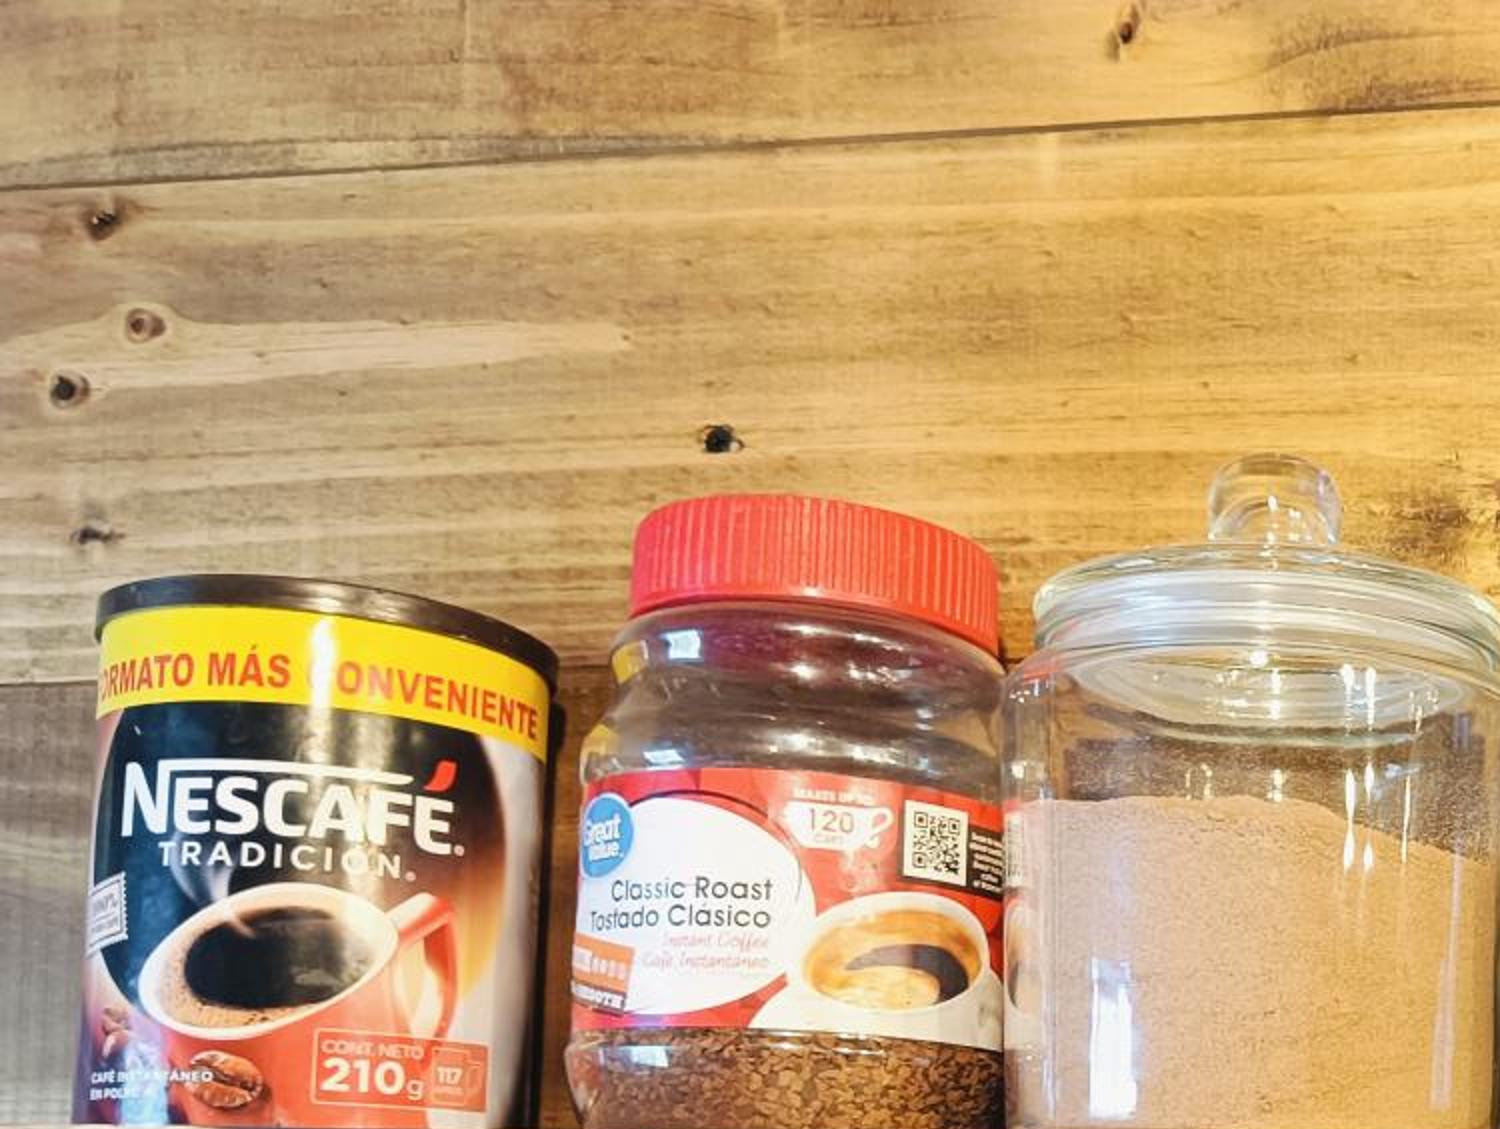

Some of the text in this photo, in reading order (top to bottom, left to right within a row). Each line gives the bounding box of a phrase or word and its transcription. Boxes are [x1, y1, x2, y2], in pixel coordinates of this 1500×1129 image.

[207, 645, 290, 688] MÁS
[308, 661, 538, 741] ONVENIENTE
[121, 758, 458, 855] NESCAFÉ
[809, 807, 855, 834] 120
[583, 812, 622, 846] Great
[611, 875, 774, 903] Classic Roast
[591, 902, 771, 932] Tostado Clásico
[378, 1043, 425, 1060] NETO
